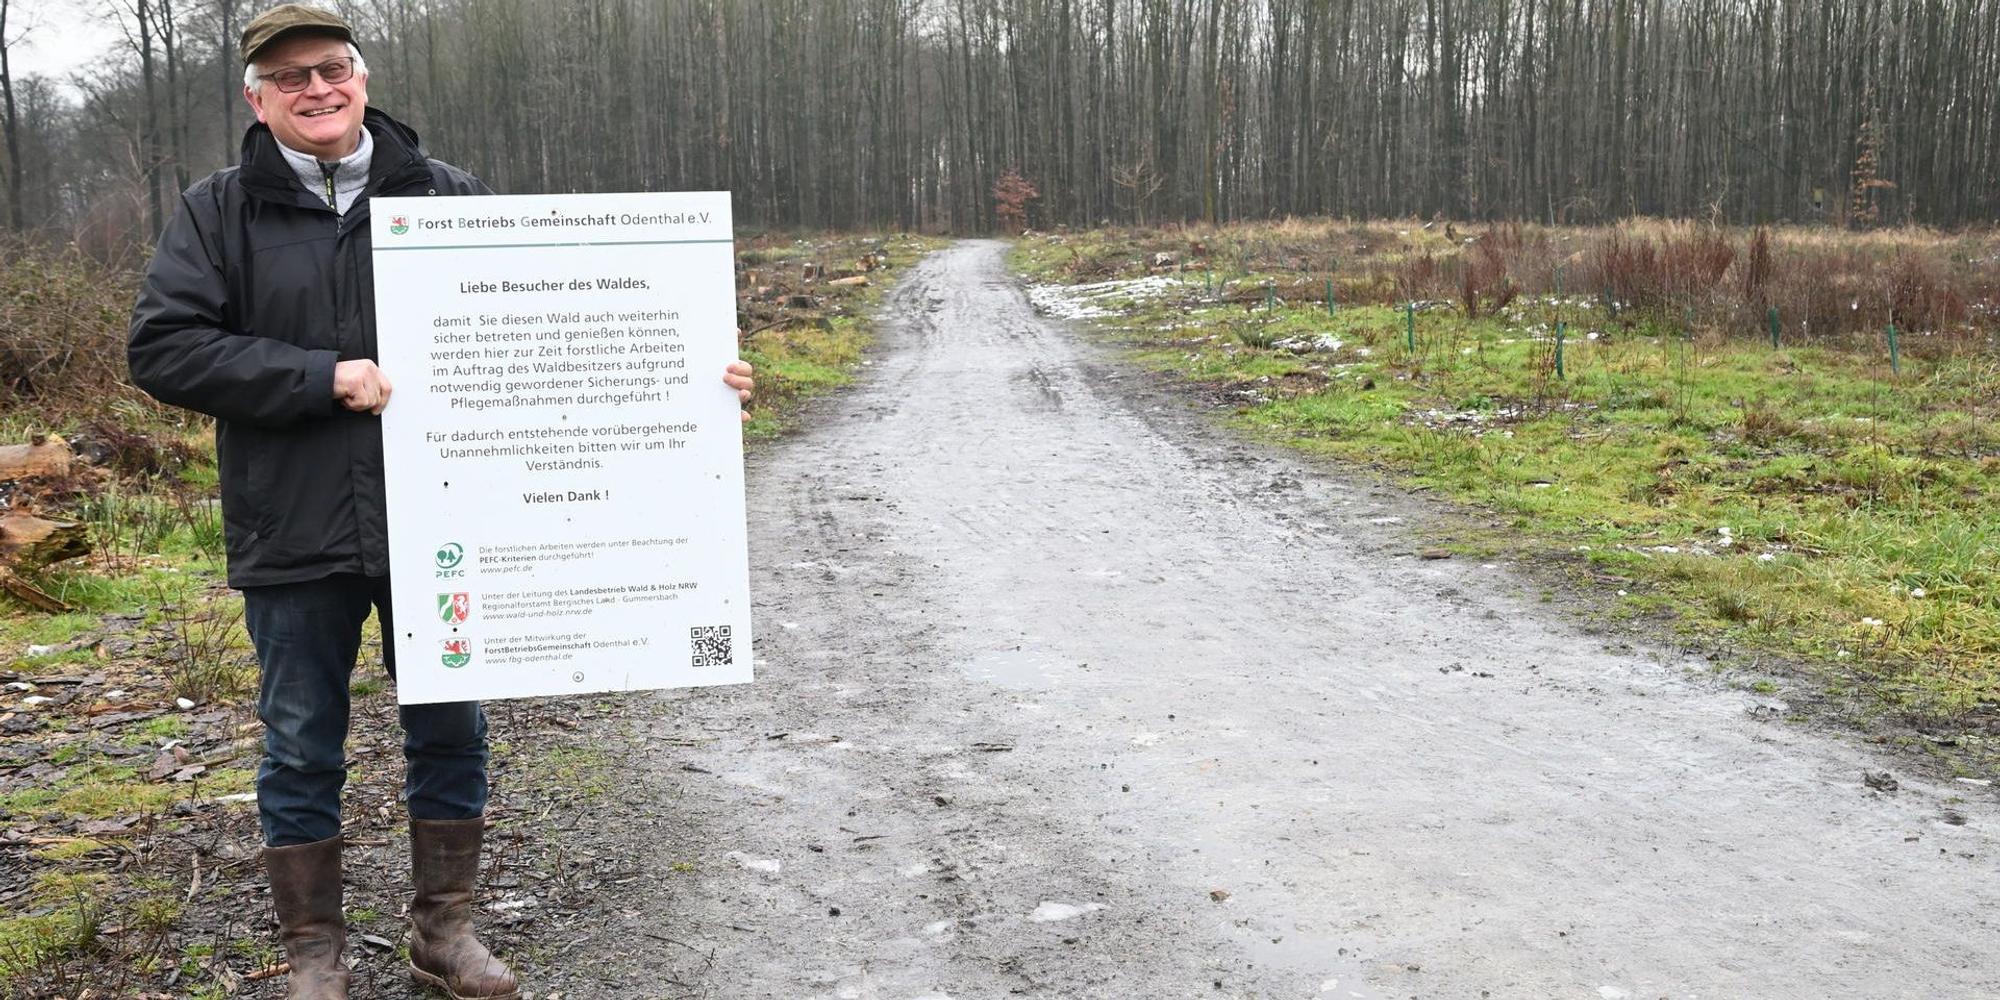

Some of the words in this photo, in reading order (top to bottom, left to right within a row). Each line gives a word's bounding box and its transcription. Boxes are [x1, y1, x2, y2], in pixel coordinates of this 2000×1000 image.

[418, 218, 453, 230] Forst
[458, 216, 516, 229] Betriebs
[520, 213, 616, 228] Gemeinschaft
[620, 212, 684, 226] Odenthal
[687, 212, 712, 224] e.V.
[460, 281, 497, 294] Liebe
[502, 279, 564, 293] Besucher
[568, 278, 592, 291] des
[596, 276, 650, 290] Waldes,
[433, 315, 472, 328] damit
[479, 314, 498, 326] Sie
[501, 314, 543, 325] diesen
[546, 312, 580, 324] Wald
[584, 311, 614, 323] auch
[618, 309, 679, 322] weiterhin
[434, 332, 471, 344] sicher
[475, 331, 532, 343] betreten
[535, 328, 561, 341] und
[564, 327, 624, 343] genießen
[628, 326, 680, 338] können,
[430, 348, 480, 360] werden
[484, 347, 509, 358] hier
[514, 349, 534, 358] zur
[538, 345, 562, 357] Zeit
[566, 343, 626, 356] forstliche
[629, 342, 685, 354] Arbeiten
[433, 365, 448, 376] im
[452, 364, 504, 378] Auftrag
[507, 362, 530, 374] des
[532, 360, 622, 373] Waldbesitzers
[625, 357, 685, 372] aufgrund
[430, 380, 501, 394] notwendig
[505, 378, 584, 394] gewordener
[587, 376, 660, 389] Sicherungs-
[664, 373, 688, 385] und
[451, 394, 573, 411] Pflegemaßnahmen
[576, 390, 662, 406] durchgeführt
[426, 432, 447, 443] Für
[451, 429, 504, 442] dadurch
[508, 426, 588, 440] entstehende
[592, 421, 698, 437] vorübergehende
[440, 443, 574, 459] Unannehmlichkeiten
[578, 441, 617, 453] bitten
[620, 440, 641, 451] wir
[645, 441, 665, 450] um
[669, 438, 686, 449] Ihr
[525, 458, 603, 471] Verständnis.
[522, 491, 564, 504] Vielen
[567, 489, 601, 502] Dank
[495, 545, 536, 553] forstlichen
[540, 543, 573, 551] Arbeiten
[632, 538, 673, 548] Beachtung
[480, 555, 536, 563] PEFC-Kriterien
[436, 570, 464, 578] PEFC
[480, 564, 533, 574] www.pefc.de
[482, 592, 504, 600] Unter
[522, 590, 552, 600] Leitung
[570, 586, 626, 596] Landesbetrieb
[482, 601, 551, 611] Regionalforstamt
[553, 598, 594, 607] Bergisches
[623, 594, 678, 602] Gummersbach
[485, 643, 590, 654] ForstBetriebsGemeinschaft
[593, 639, 630, 648] Odenthal
[632, 638, 649, 646] e.V.
[524, 633, 570, 642] Mitwirkung
[485, 653, 573, 665] www.fbg-odenthal.de
